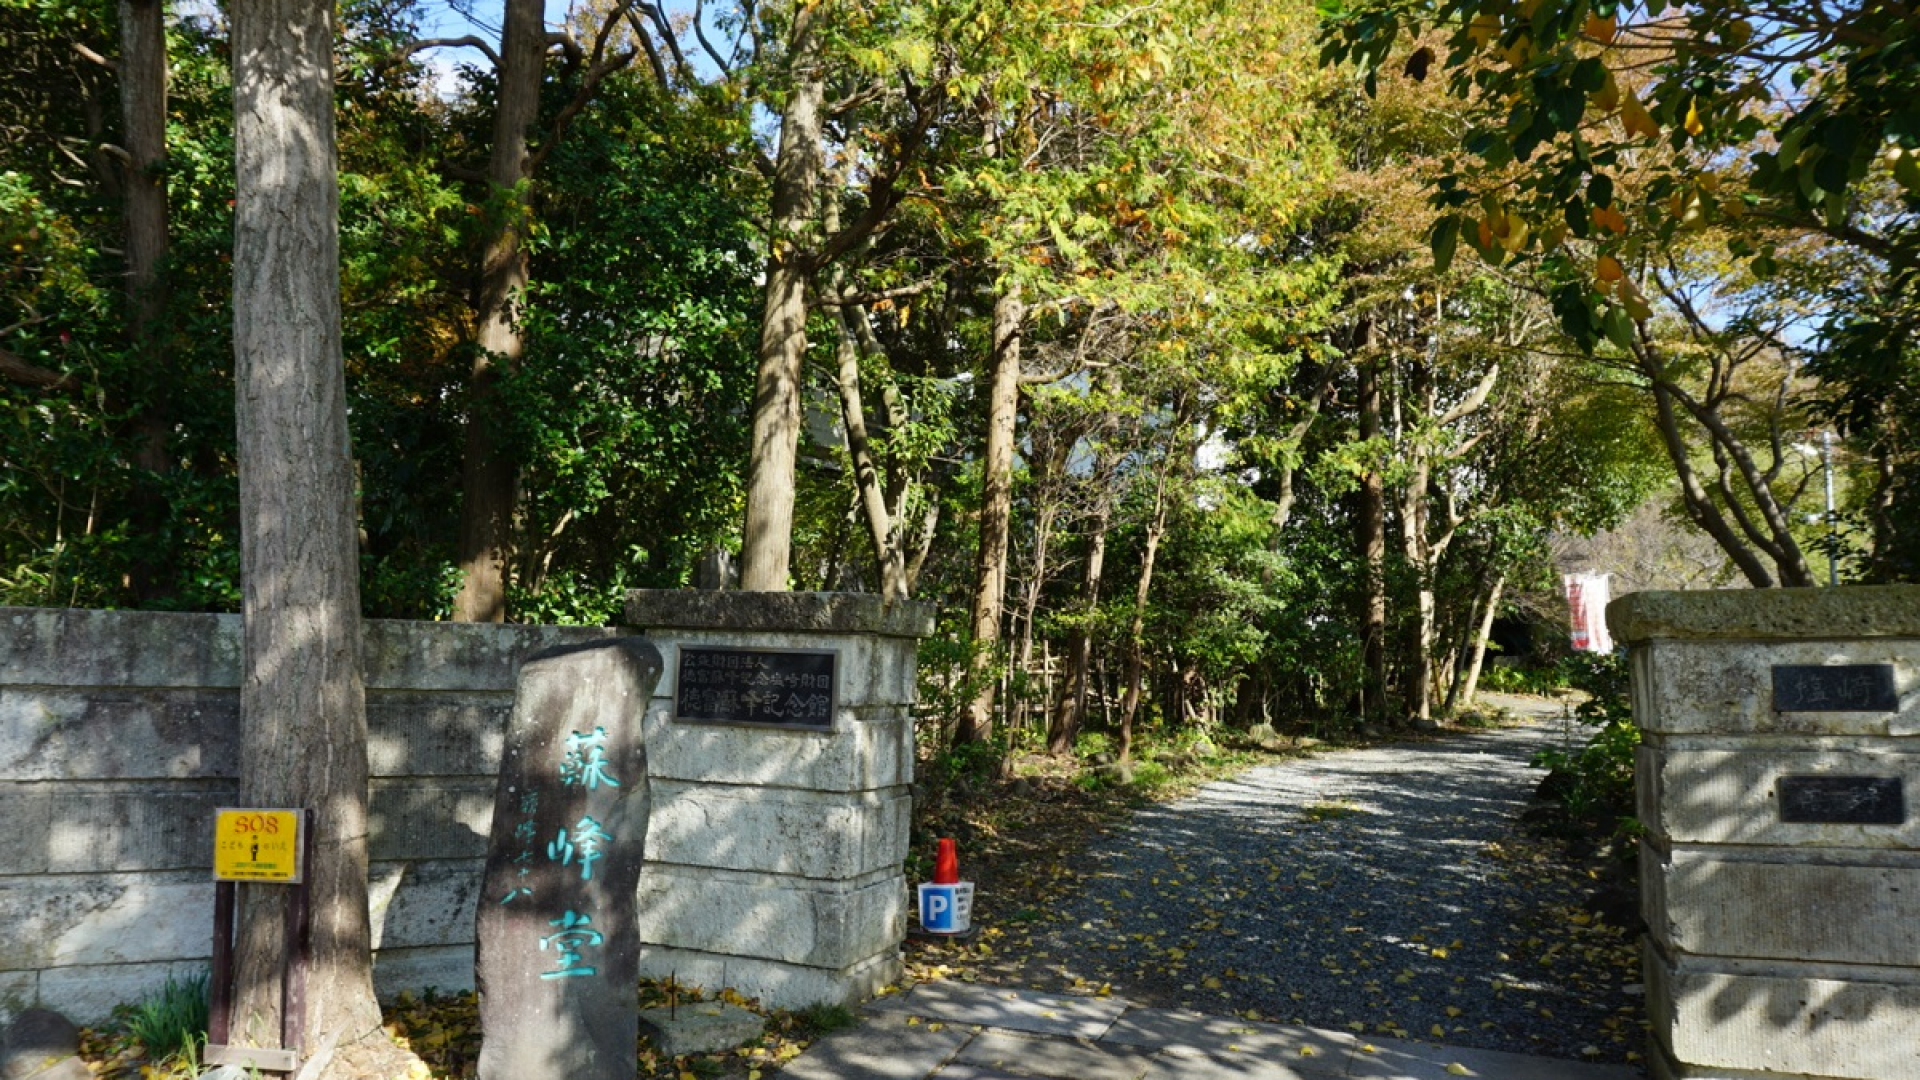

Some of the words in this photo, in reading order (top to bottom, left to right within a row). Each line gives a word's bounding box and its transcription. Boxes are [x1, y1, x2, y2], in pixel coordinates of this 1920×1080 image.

[683, 652, 769, 669] 公益財団法人
[234, 814, 279, 835] SOS
[539, 726, 621, 980] 蘇峰堂
[928, 895, 948, 921] P
